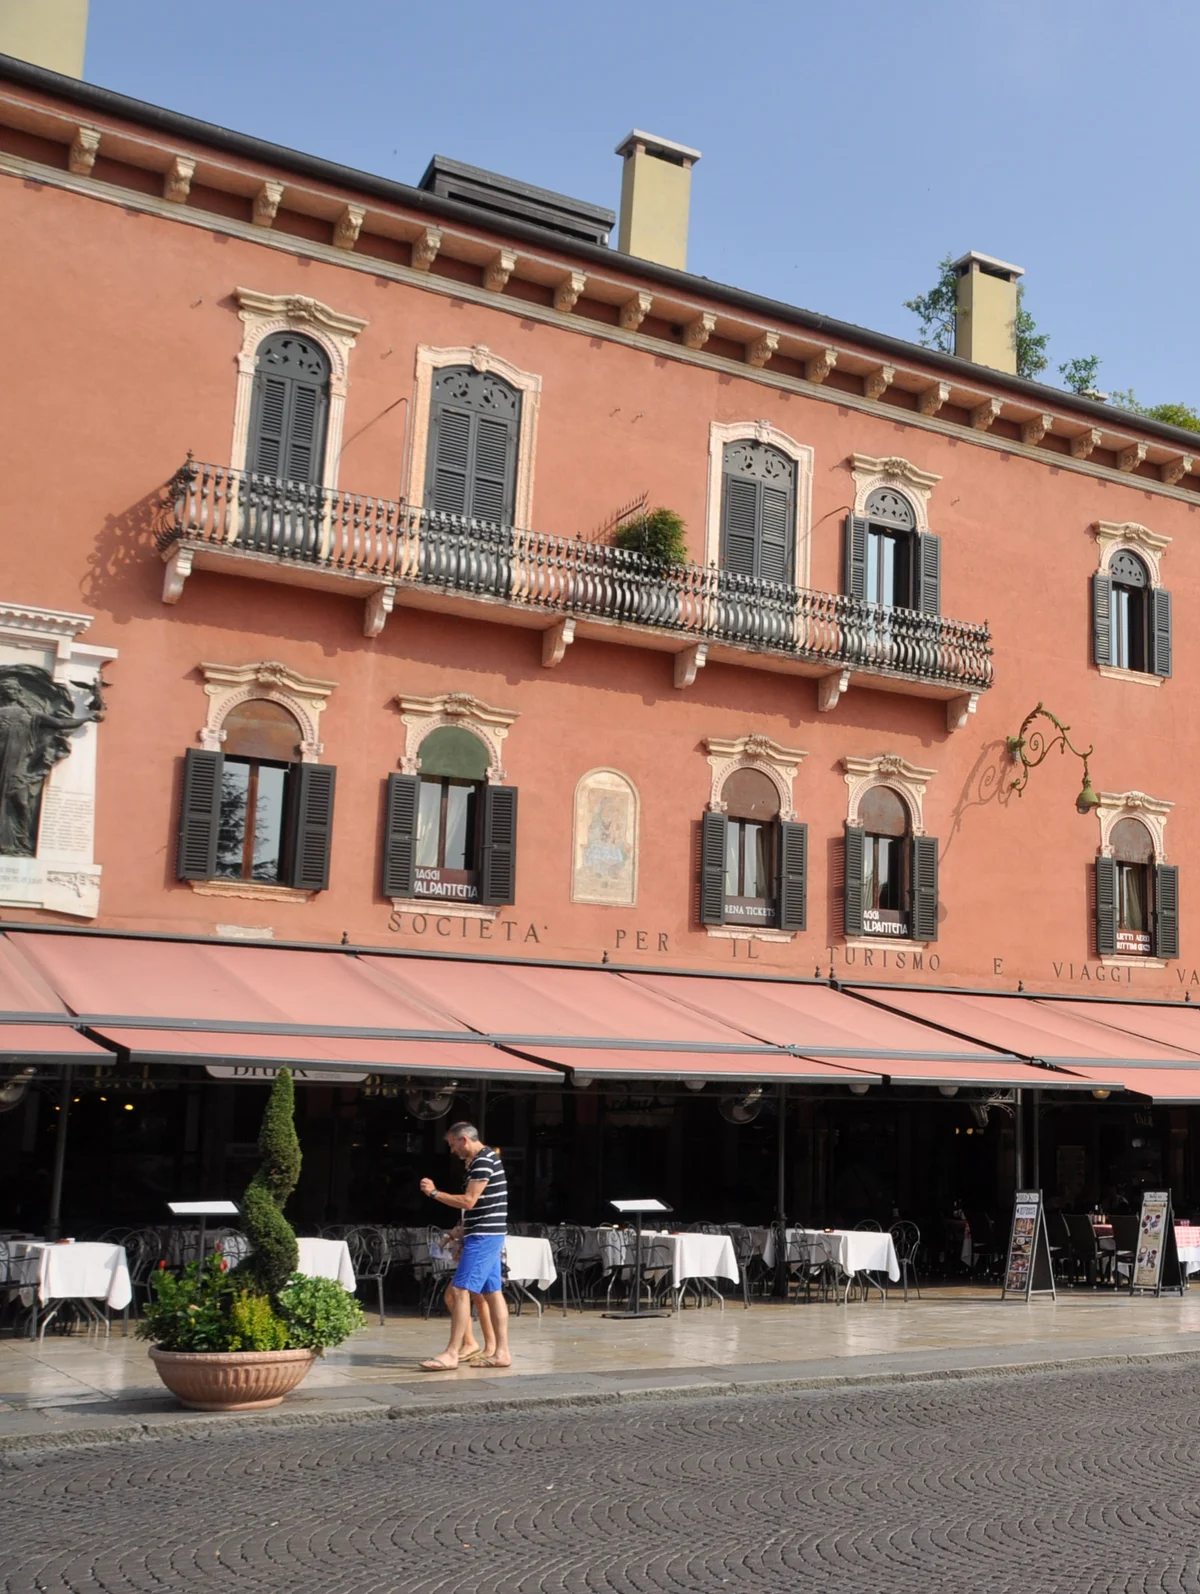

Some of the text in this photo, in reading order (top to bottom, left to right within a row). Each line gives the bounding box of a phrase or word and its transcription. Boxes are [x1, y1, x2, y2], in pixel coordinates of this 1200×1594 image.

[415, 868, 440, 880] IAGGI
[745, 906, 776, 917] TICKETS
[387, 912, 548, 943] SOCIETA'
[615, 929, 669, 952] PER
[732, 938, 759, 959] IL
[825, 946, 941, 971] TURISMO
[993, 957, 1004, 975] E
[1052, 961, 1132, 983] VIAGGI
